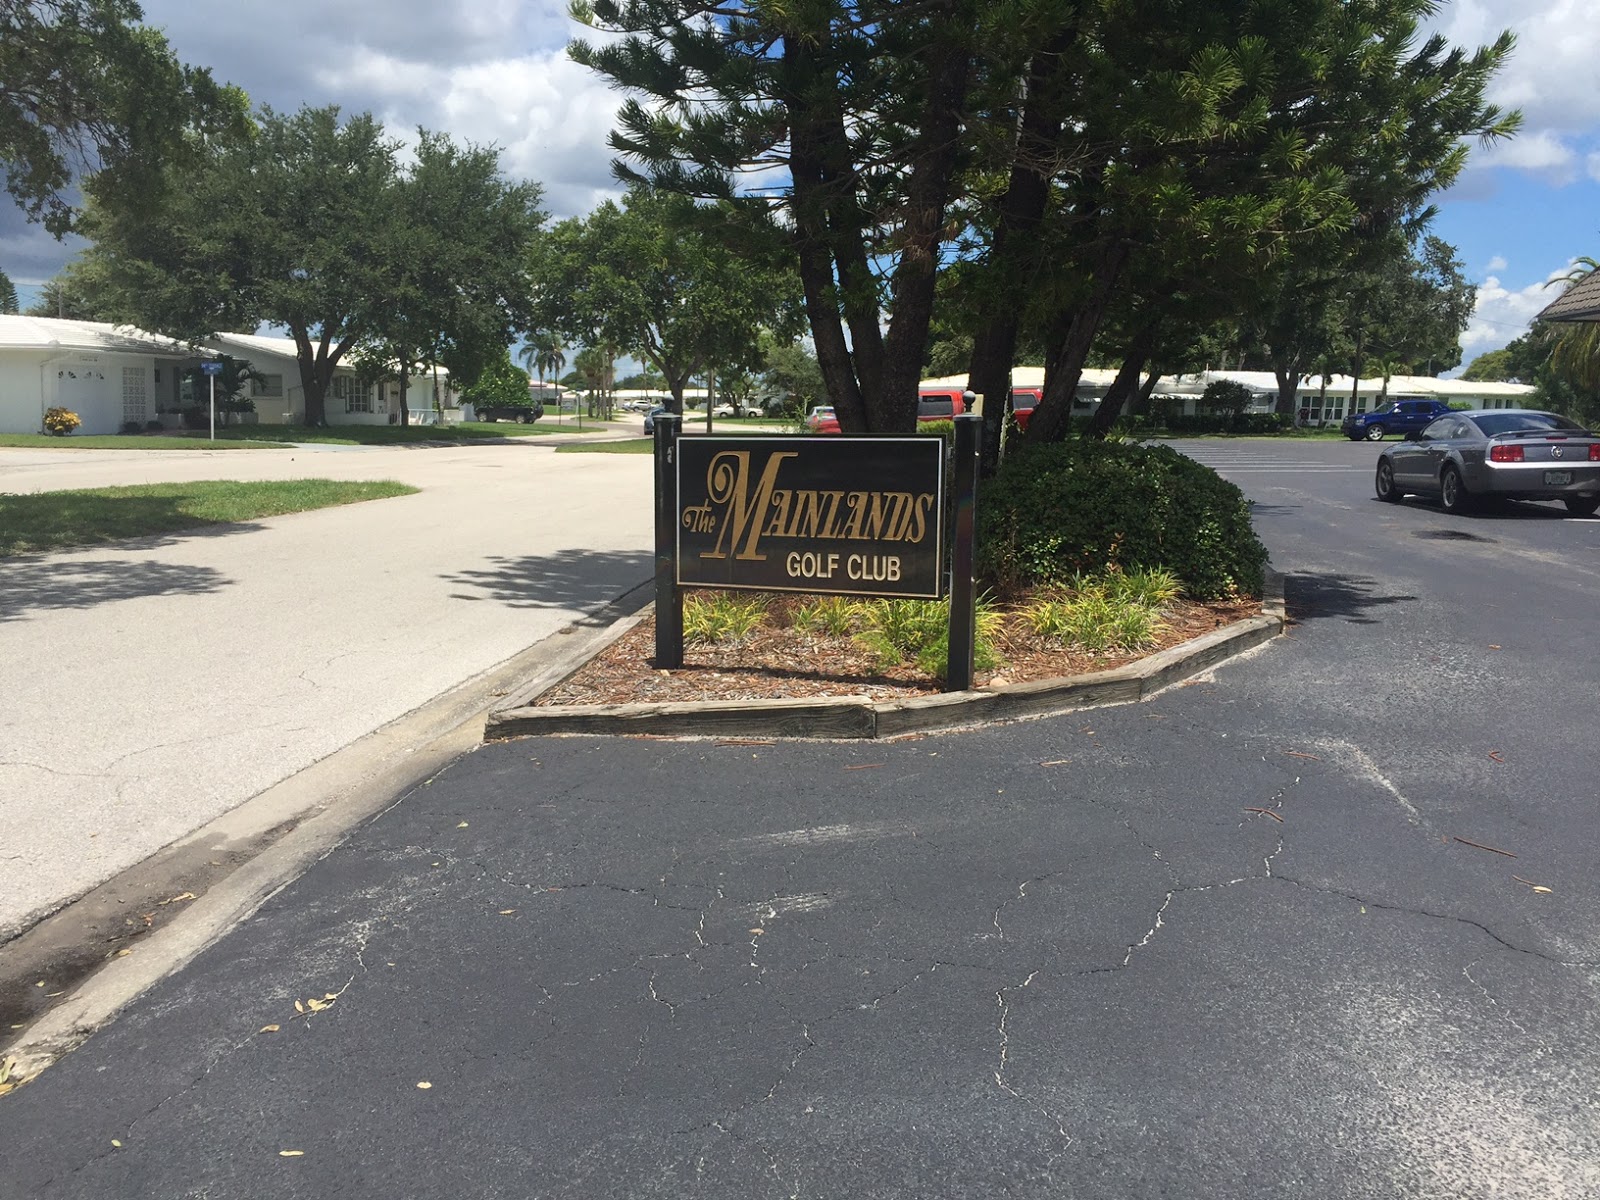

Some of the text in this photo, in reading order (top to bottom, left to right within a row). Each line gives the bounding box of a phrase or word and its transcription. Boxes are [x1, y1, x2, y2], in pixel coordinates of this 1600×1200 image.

[682, 451, 934, 561] The MAINLANDS
[786, 552, 900, 581] GOLF CLUB
